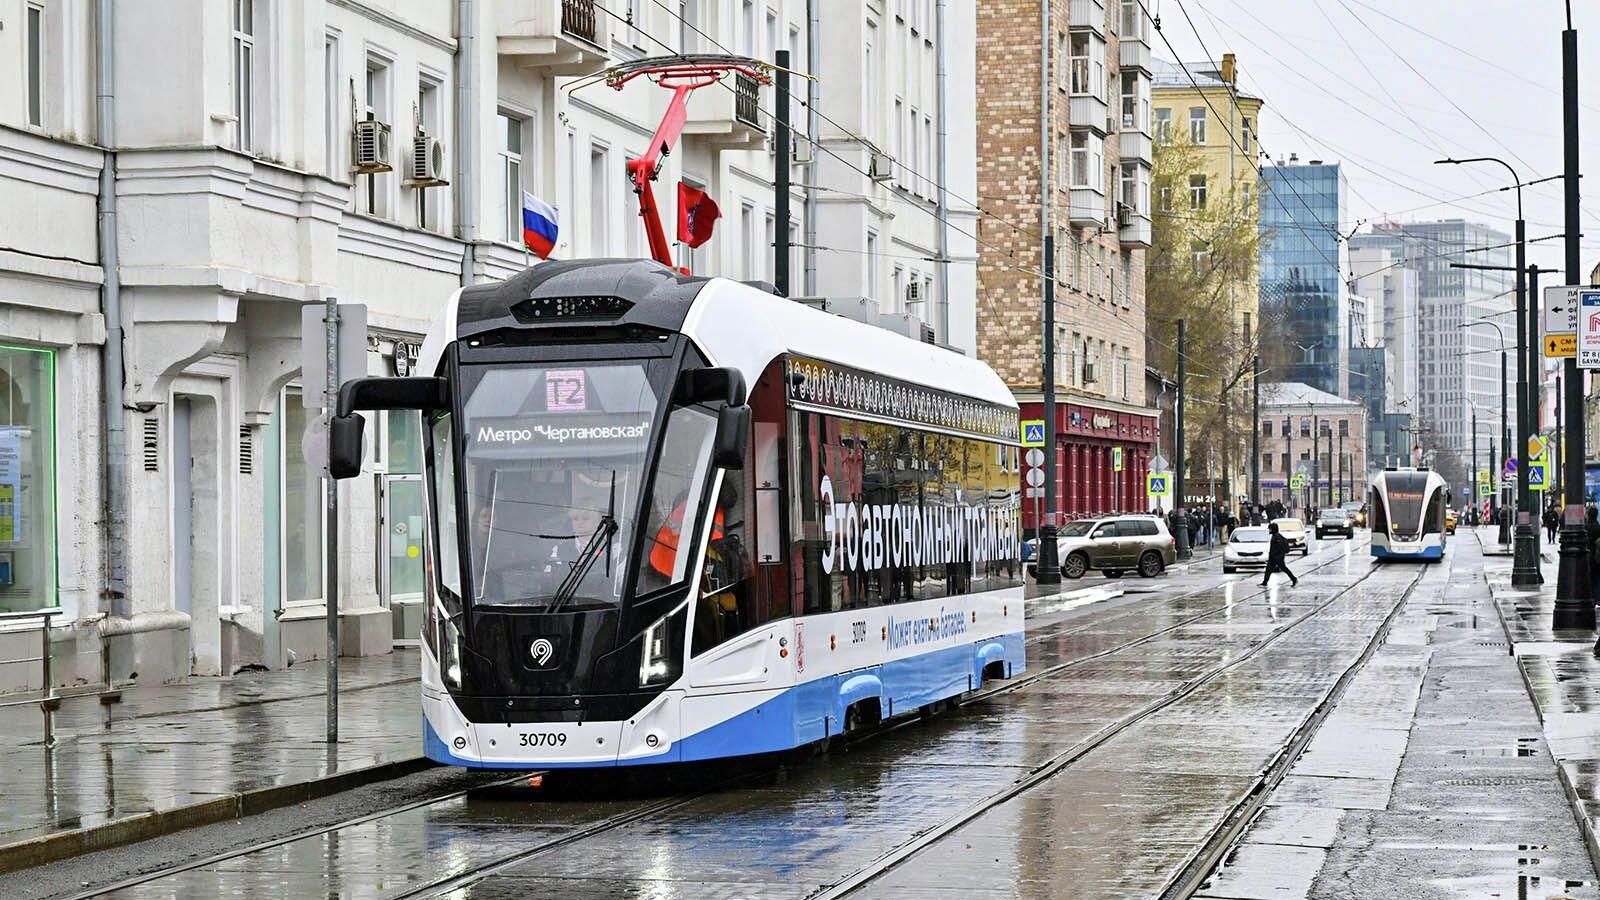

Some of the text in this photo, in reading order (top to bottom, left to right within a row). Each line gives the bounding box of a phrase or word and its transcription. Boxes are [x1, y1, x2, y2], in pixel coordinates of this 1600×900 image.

[547, 377, 585, 405] Т2
[477, 421, 650, 445] Метро "Чертановская"
[820, 474, 859, 575] Это
[862, 488, 964, 573] автономный
[886, 615, 912, 652] Может
[913, 617, 931, 646] ехать
[518, 732, 568, 748] 30709
